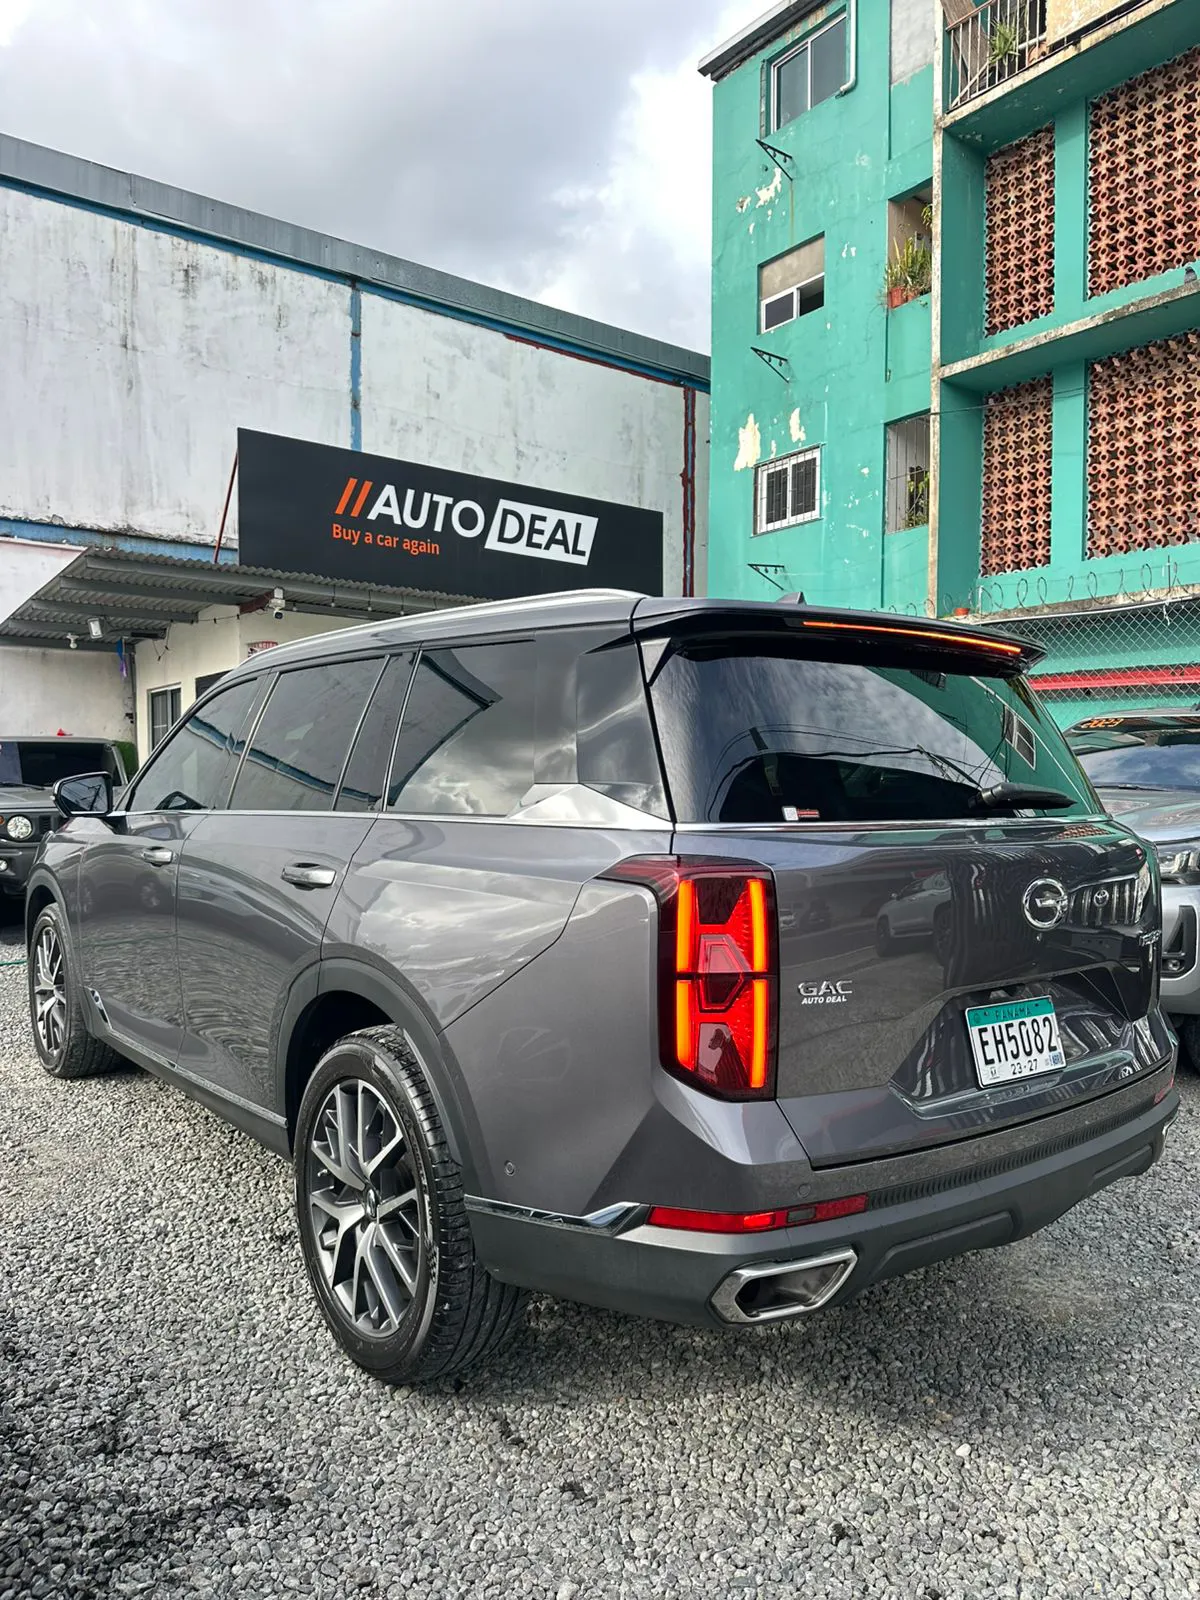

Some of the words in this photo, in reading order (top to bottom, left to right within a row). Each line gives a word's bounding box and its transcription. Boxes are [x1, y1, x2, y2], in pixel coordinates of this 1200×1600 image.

[332, 523, 360, 546] Buy
[364, 531, 373, 544] a
[376, 534, 399, 548] car
[402, 538, 440, 555] again
[497, 507, 587, 557] DEAL
[798, 980, 853, 996] GAC
[801, 996, 824, 1005] AUTO
[825, 995, 848, 1004] DEAL
[978, 1016, 1058, 1066] EH5082
